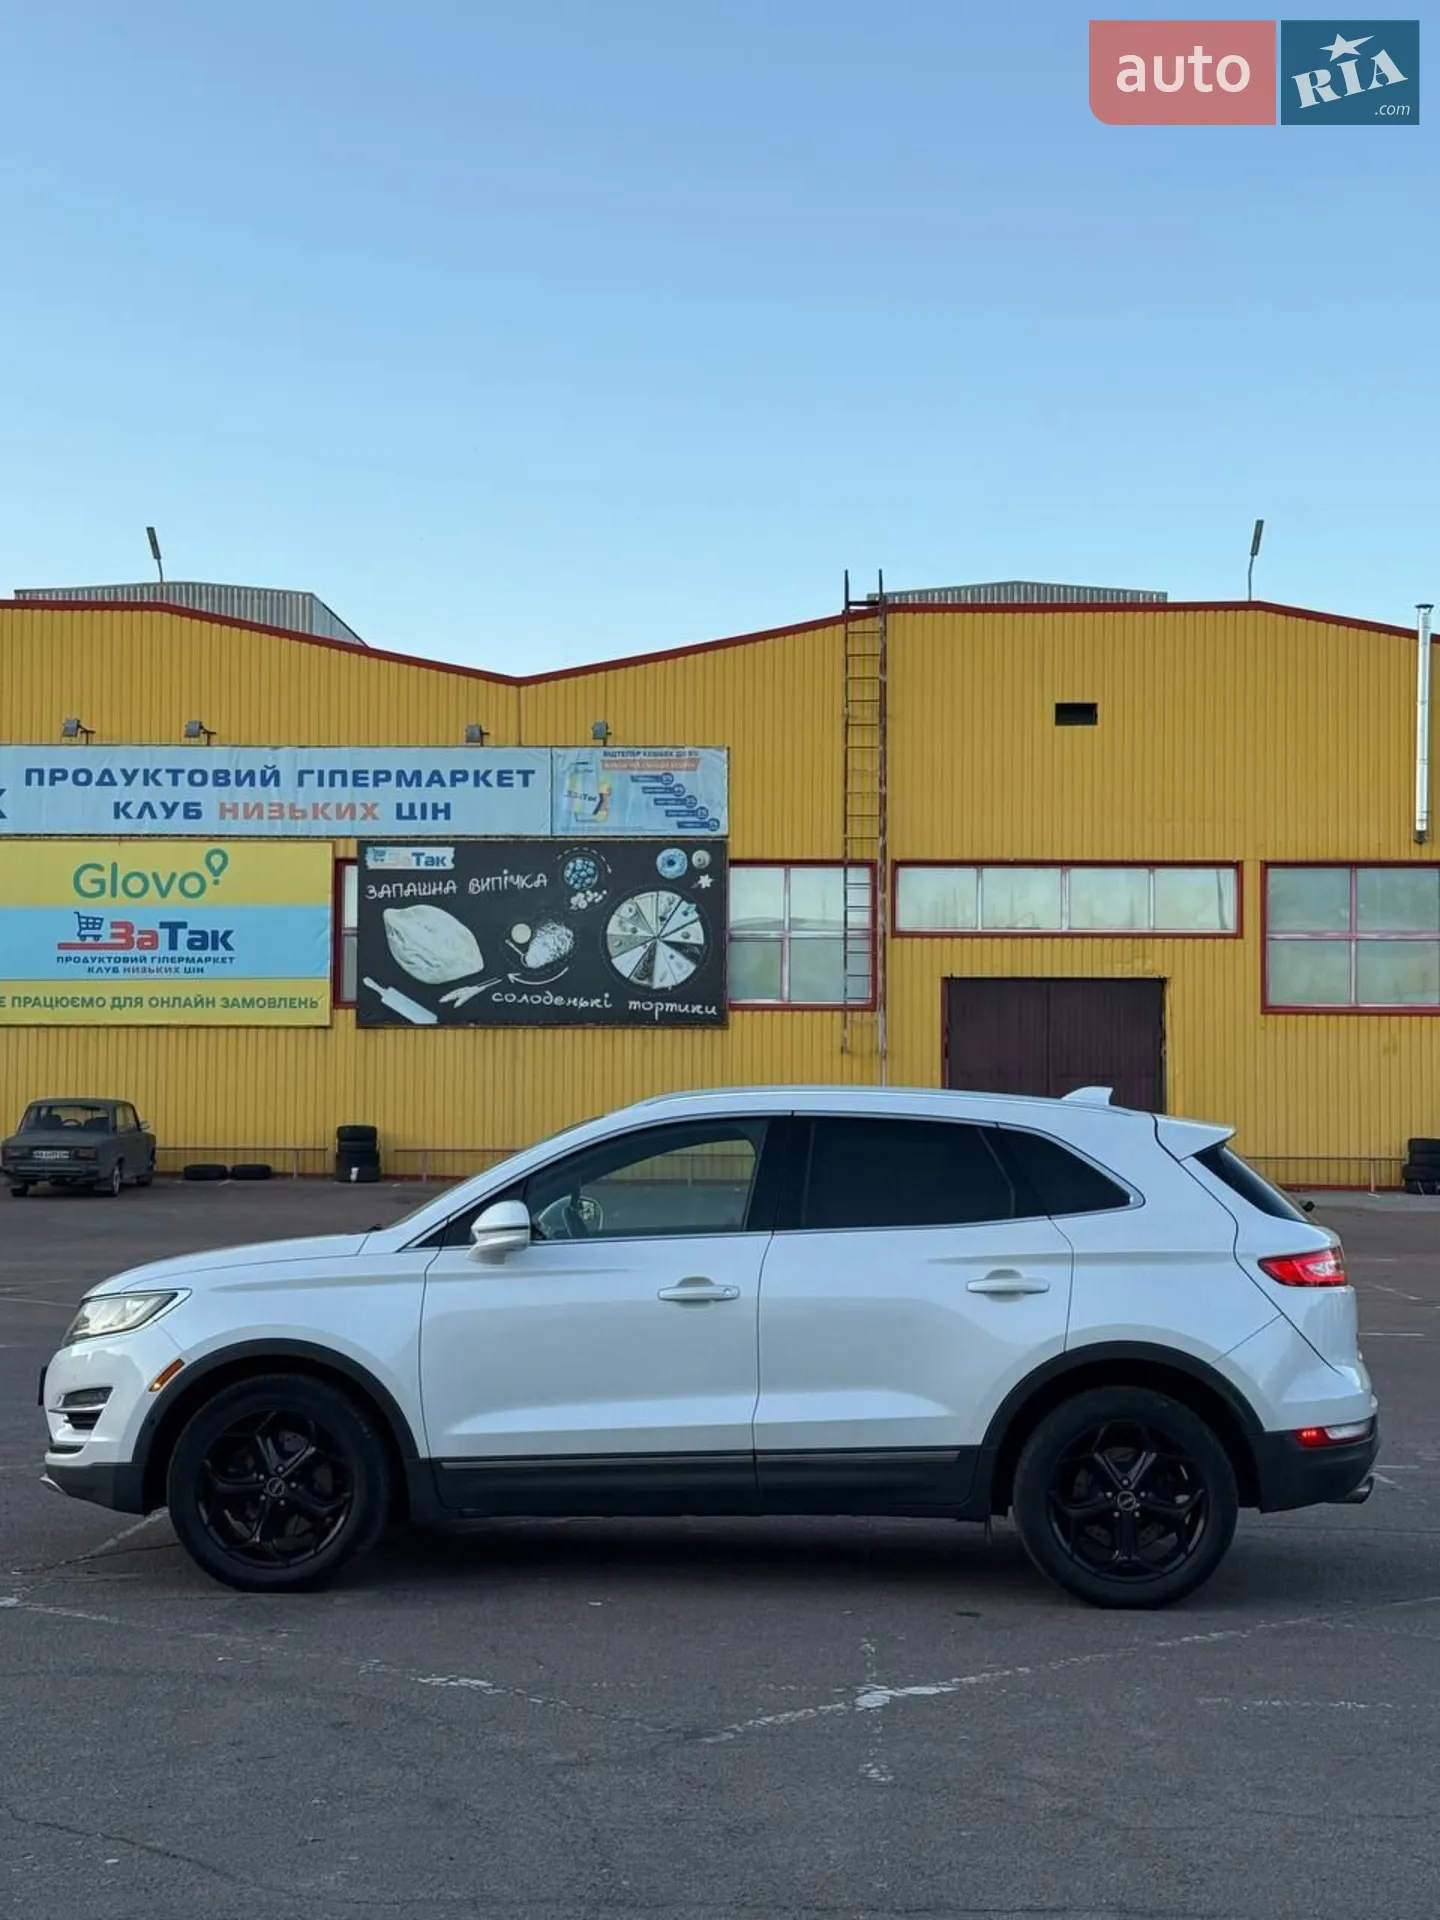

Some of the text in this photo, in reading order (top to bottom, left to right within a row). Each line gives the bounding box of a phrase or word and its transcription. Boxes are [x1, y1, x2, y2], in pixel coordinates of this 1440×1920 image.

[25, 764, 536, 788] ПРОДУКТОВИЙ ГІПЕРМАРКЕТ
[113, 801, 451, 822] КЛУБ НИЗЬКИХ ЦІН
[73, 862, 207, 899] Glovo
[365, 869, 549, 900] ЗАПАШНА ВИПІЧКА
[109, 921, 235, 951] ЗаТак
[56, 955, 235, 964] ПРОДУКТОВИЙ ГІПЕРМАРКЕТ
[87, 966, 205, 974] КЛУБ НИЗЬКИХ ЦІН
[11, 996, 107, 1010] ПРАЦЮЄМО
[110, 996, 144, 1010] ДЛЯ
[148, 993, 216, 1009] ОНЛАЙН
[220, 996, 319, 1009] ЗАМОВЛЕНЬ
